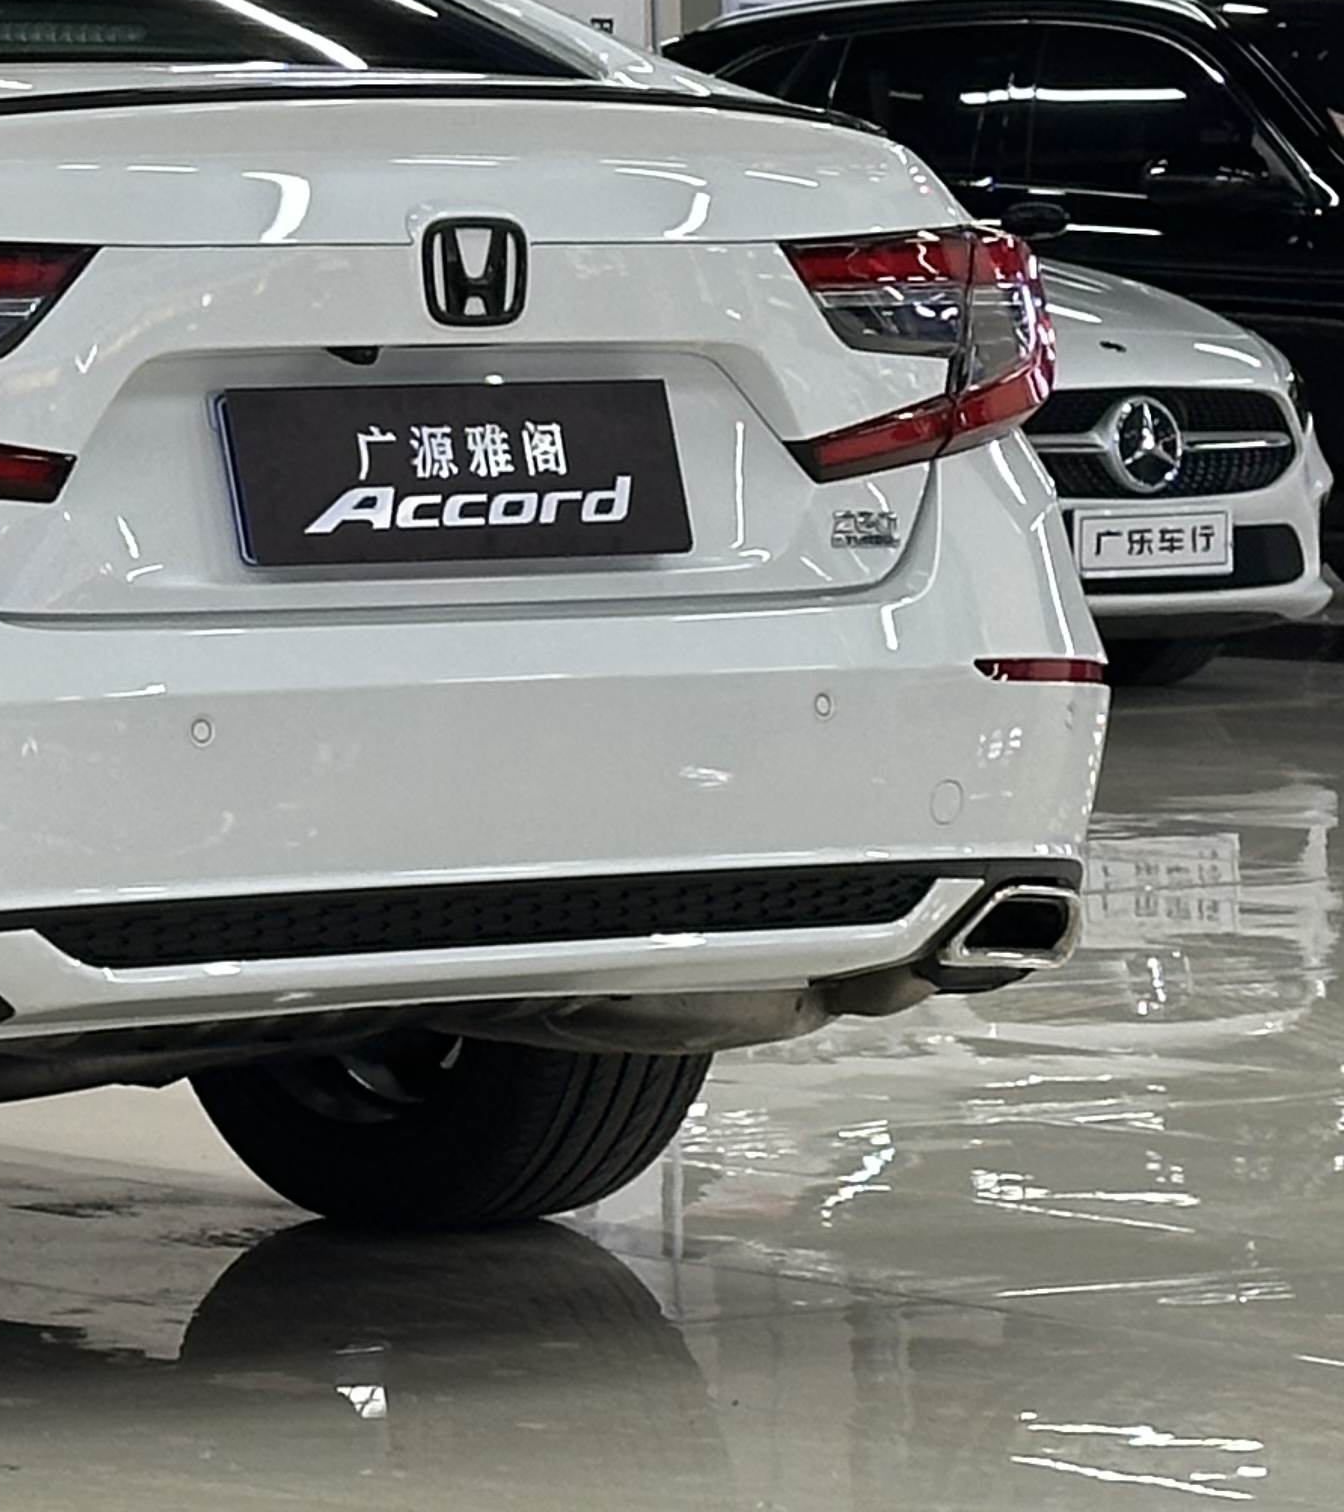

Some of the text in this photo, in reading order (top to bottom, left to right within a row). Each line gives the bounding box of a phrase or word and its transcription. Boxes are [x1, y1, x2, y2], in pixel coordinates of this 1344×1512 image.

[355, 421, 569, 481] 广源雅阁
[304, 475, 632, 535] Accord
[1094, 525, 1215, 556] 广乐车行
